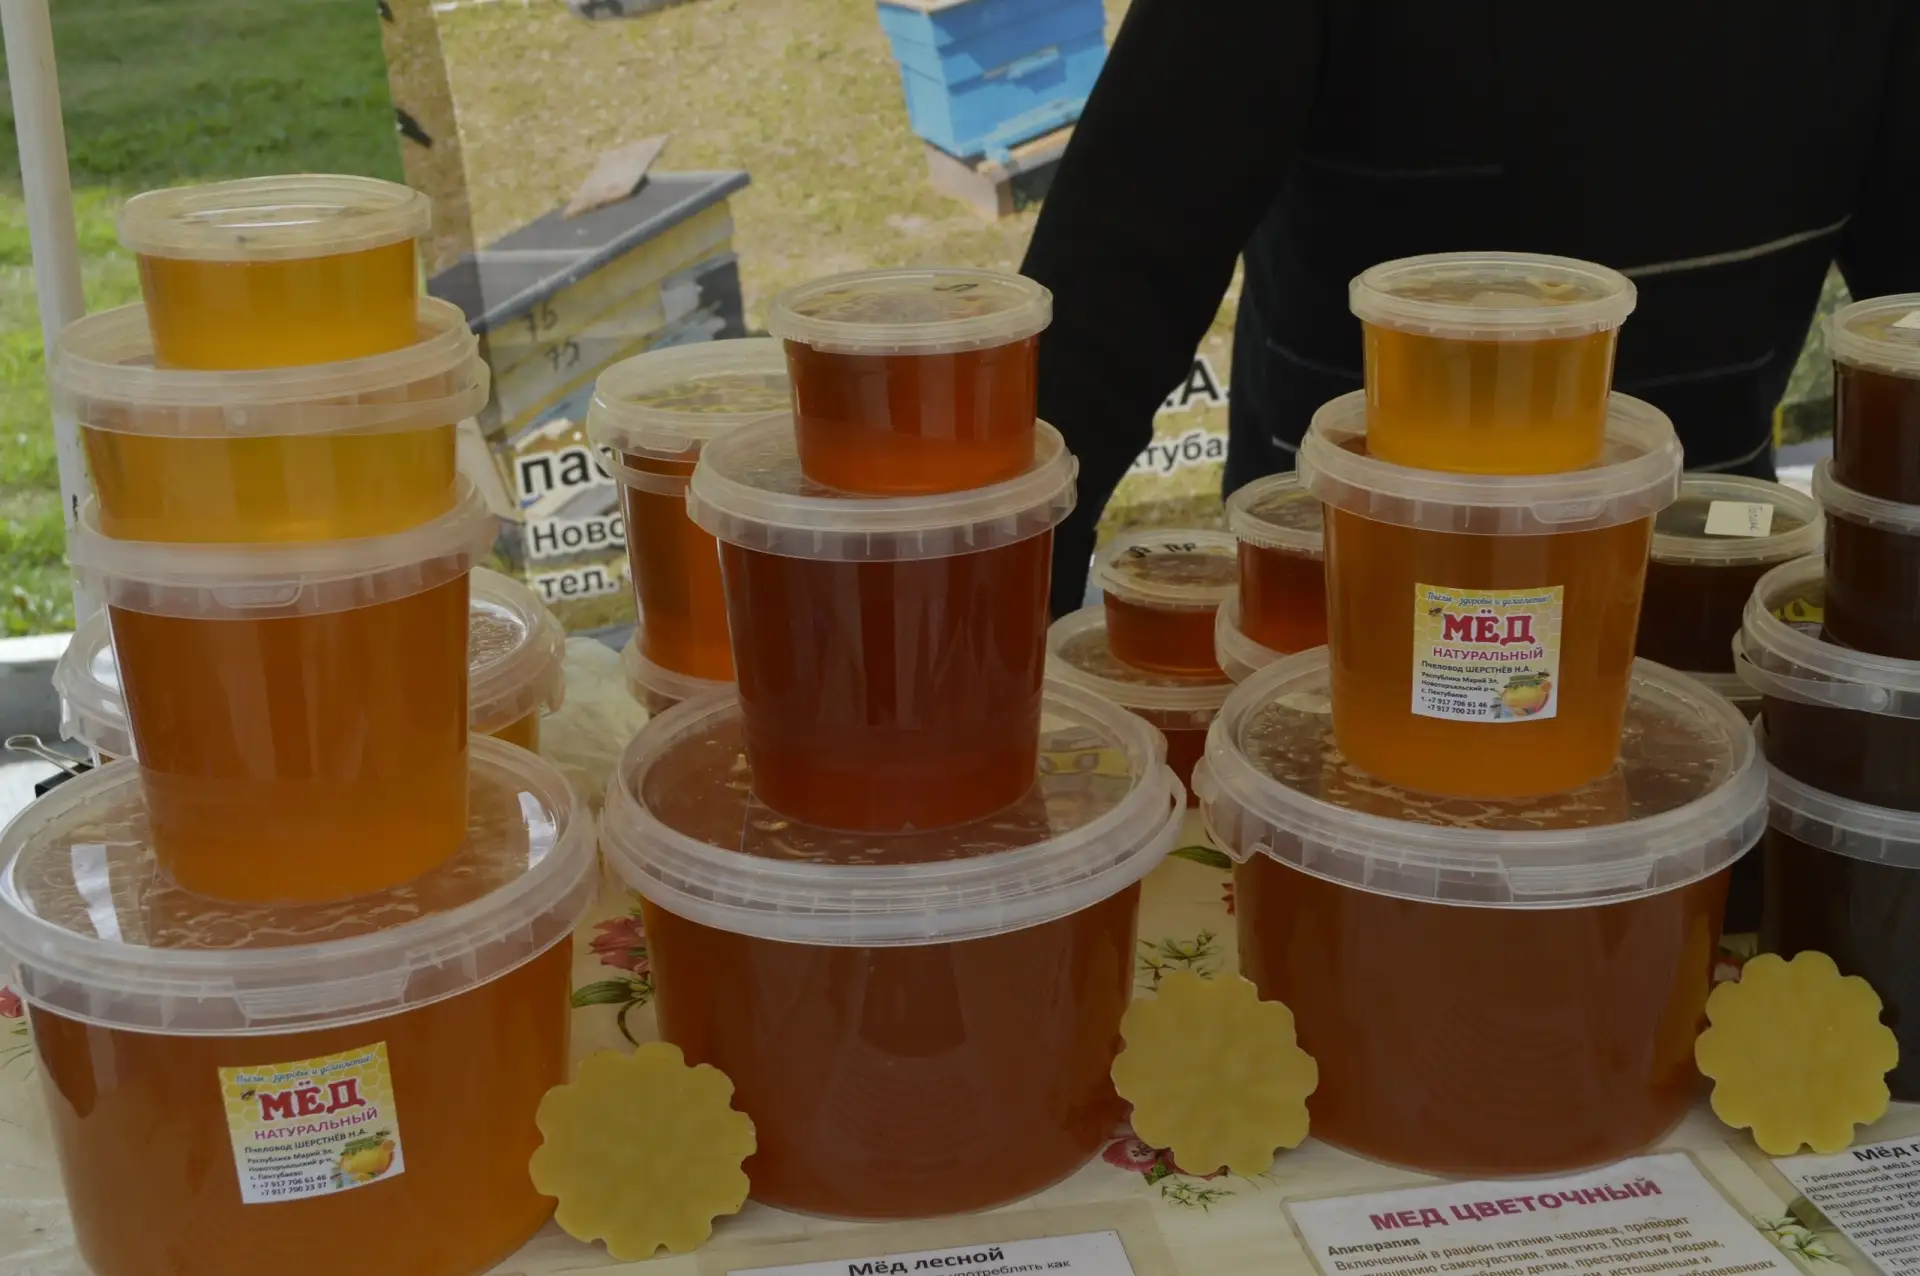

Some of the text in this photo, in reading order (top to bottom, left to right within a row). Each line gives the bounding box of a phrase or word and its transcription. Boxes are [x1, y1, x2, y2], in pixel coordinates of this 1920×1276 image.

[539, 571, 614, 597] тел.
[1442, 609, 1536, 646] МЁД
[1433, 647, 1544, 661] НАТУРАЛЬНЫЙ
[1421, 660, 1532, 674] Пчеловод ШЕРСТНЁВ Н.А.
[1421, 672, 1461, 684] Республика
[1462, 676, 1487, 685] Марий
[1421, 680, 1482, 692] Новоторъяльский
[1428, 688, 1468, 699] Пектубаево
[1437, 698, 1451, 706] 917
[1452, 700, 1465, 708] 706
[1437, 705, 1450, 713] 917
[258, 1078, 367, 1121] МЁД
[254, 1107, 378, 1141] НАТУРАЛЬНЫЙ
[244, 1140, 293, 1154] Пчеловод
[294, 1132, 347, 1149] ШЕРСТНЁВ
[247, 1154, 292, 1165] Республика
[293, 1149, 321, 1160] Марий
[1852, 1146, 1911, 1162] Мёд
[271, 1179, 286, 1188] 917
[288, 1177, 302, 1186] 706
[304, 1175, 313, 1184] 61
[315, 1173, 327, 1182] 46
[1802, 1164, 1880, 1183] Гречишный
[271, 1186, 286, 1196] 917
[288, 1184, 303, 1194] 700
[305, 1183, 315, 1192] 23
[317, 1181, 327, 1190] 37
[1805, 1174, 1893, 1194] дыхательной
[1369, 1177, 1663, 1231] МЕД ЦВЕТОЧНЫЙ
[1812, 1193, 1834, 1202] Он
[1823, 1197, 1881, 1211] веществ
[1840, 1203, 1906, 1219] Помогает
[1328, 1237, 1421, 1256] Апитерапия
[1335, 1216, 1689, 1271] Включенный в рацион питания человека, приводит
[1440, 1250, 1543, 1271] самочувствия,
[1545, 1241, 1611, 1257] аппетита.
[1611, 1233, 1672, 1249] Поэтому
[1674, 1230, 1693, 1239] он
[847, 1246, 1005, 1276] Мёд лесной
[1526, 1260, 1575, 1275] детям,
[1574, 1247, 1670, 1268] престарелым
[1672, 1238, 1725, 1254] людям,
[1047, 1261, 1071, 1269] как
[1608, 1257, 1700, 1276] истощенным
[1701, 1255, 1712, 1264] и
